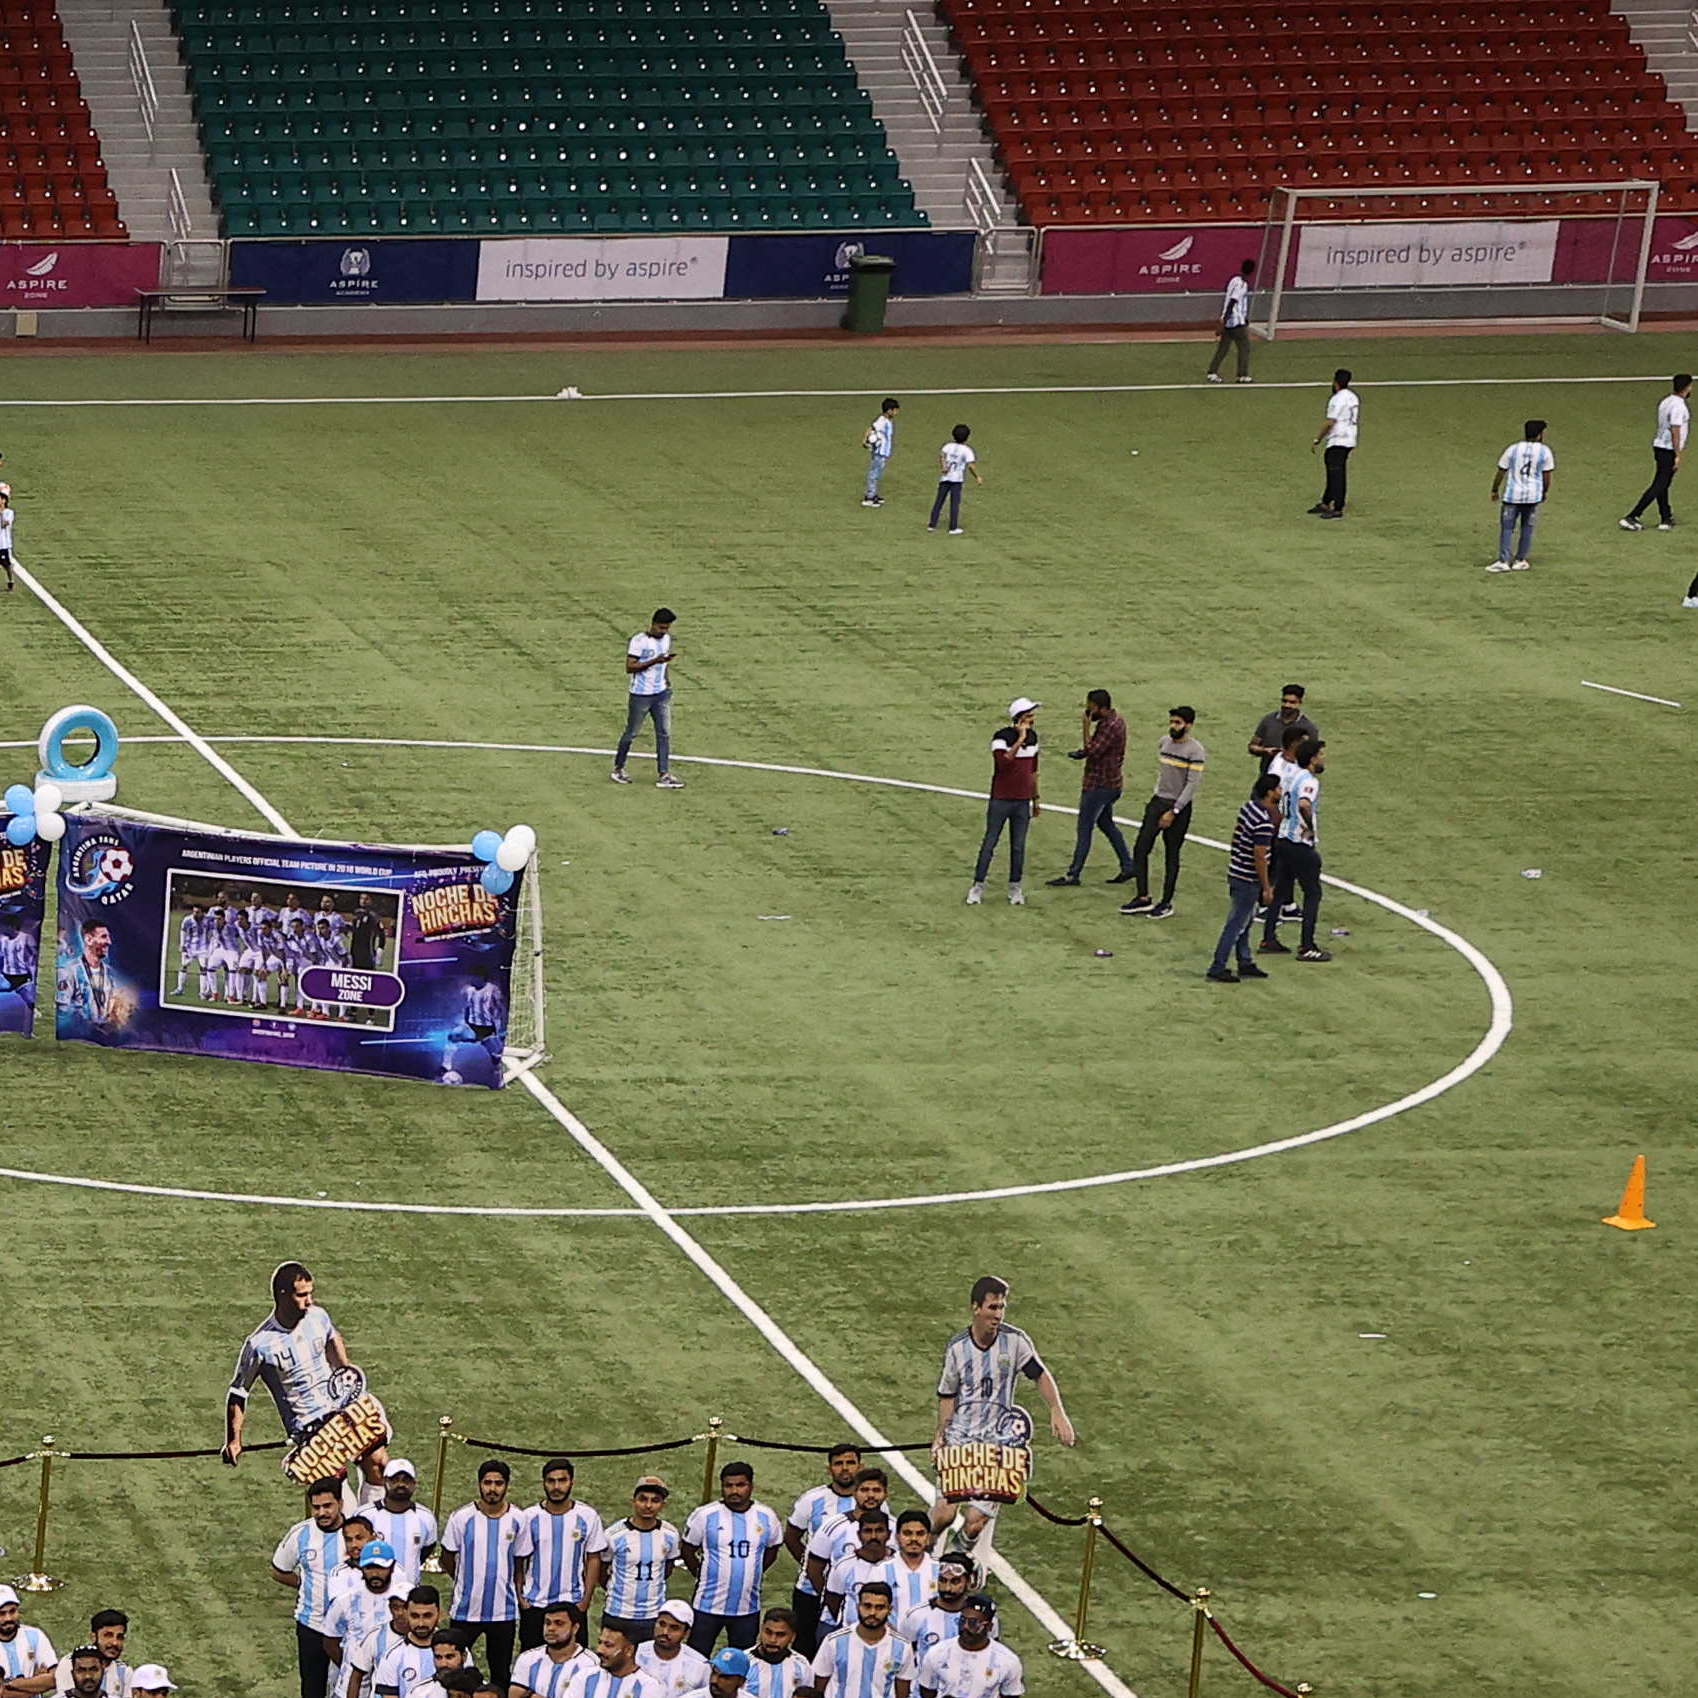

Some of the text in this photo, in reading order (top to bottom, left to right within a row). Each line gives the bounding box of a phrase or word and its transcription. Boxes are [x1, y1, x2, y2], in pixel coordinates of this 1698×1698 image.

[1326, 242, 1517, 267] inspired by aspire
[505, 258, 688, 281] inspired by aspire
[1138, 263, 1202, 275] ASPIRE
[6, 279, 68, 291] ASPIRE
[329, 278, 379, 289] ASPIRE
[1519, 459, 1533, 478] 4
[1, 848, 29, 871] DE
[281, 859, 300, 868] TEAM
[411, 884, 470, 915] NOCHE
[418, 902, 496, 933] HINCHAS
[331, 972, 372, 991] MESSI
[337, 989, 363, 1002] ZONE
[274, 1347, 297, 1372] 14
[980, 1376, 994, 1399] 10
[290, 1393, 379, 1482] NOCHE DE
[936, 1443, 1028, 1474] NOCHE DE
[941, 1466, 1023, 1495] HINCHAS
[727, 1538, 750, 1559] 10
[635, 1561, 654, 1581] 11
